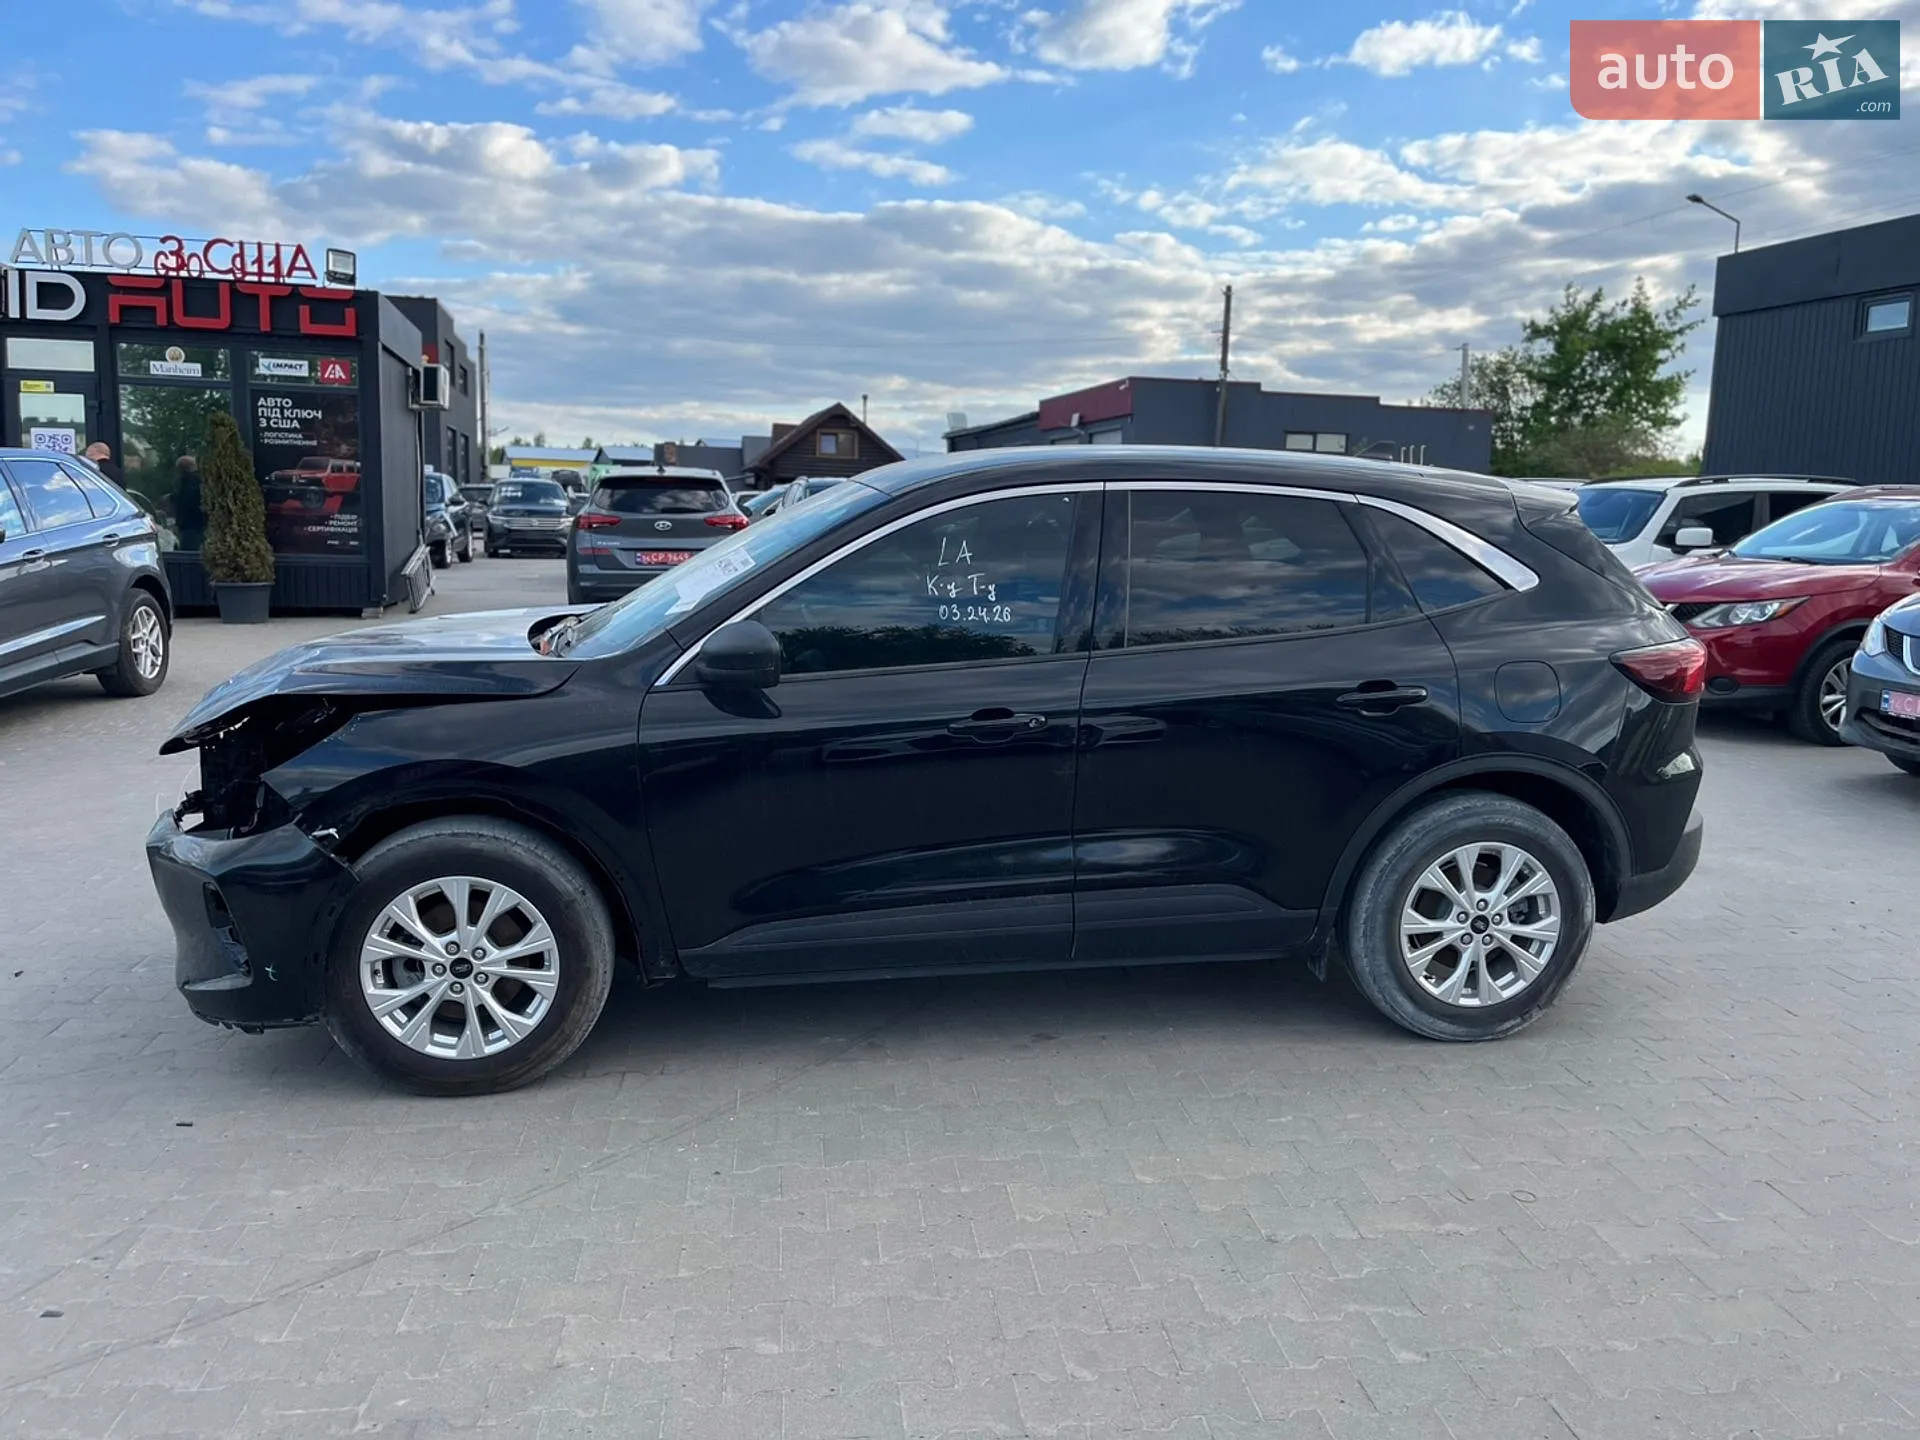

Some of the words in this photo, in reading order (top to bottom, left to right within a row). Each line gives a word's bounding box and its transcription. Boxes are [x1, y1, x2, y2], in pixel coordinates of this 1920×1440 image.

[10, 228, 143, 269] АВТО
[203, 236, 317, 279] США
[107, 275, 357, 337] AUTO
[152, 363, 200, 375] Manheim
[272, 362, 304, 371] IMPACT
[257, 396, 292, 407] АВТО
[258, 407, 281, 418] ПІД
[284, 408, 322, 420] КЛЮЧ
[269, 418, 300, 428] США
